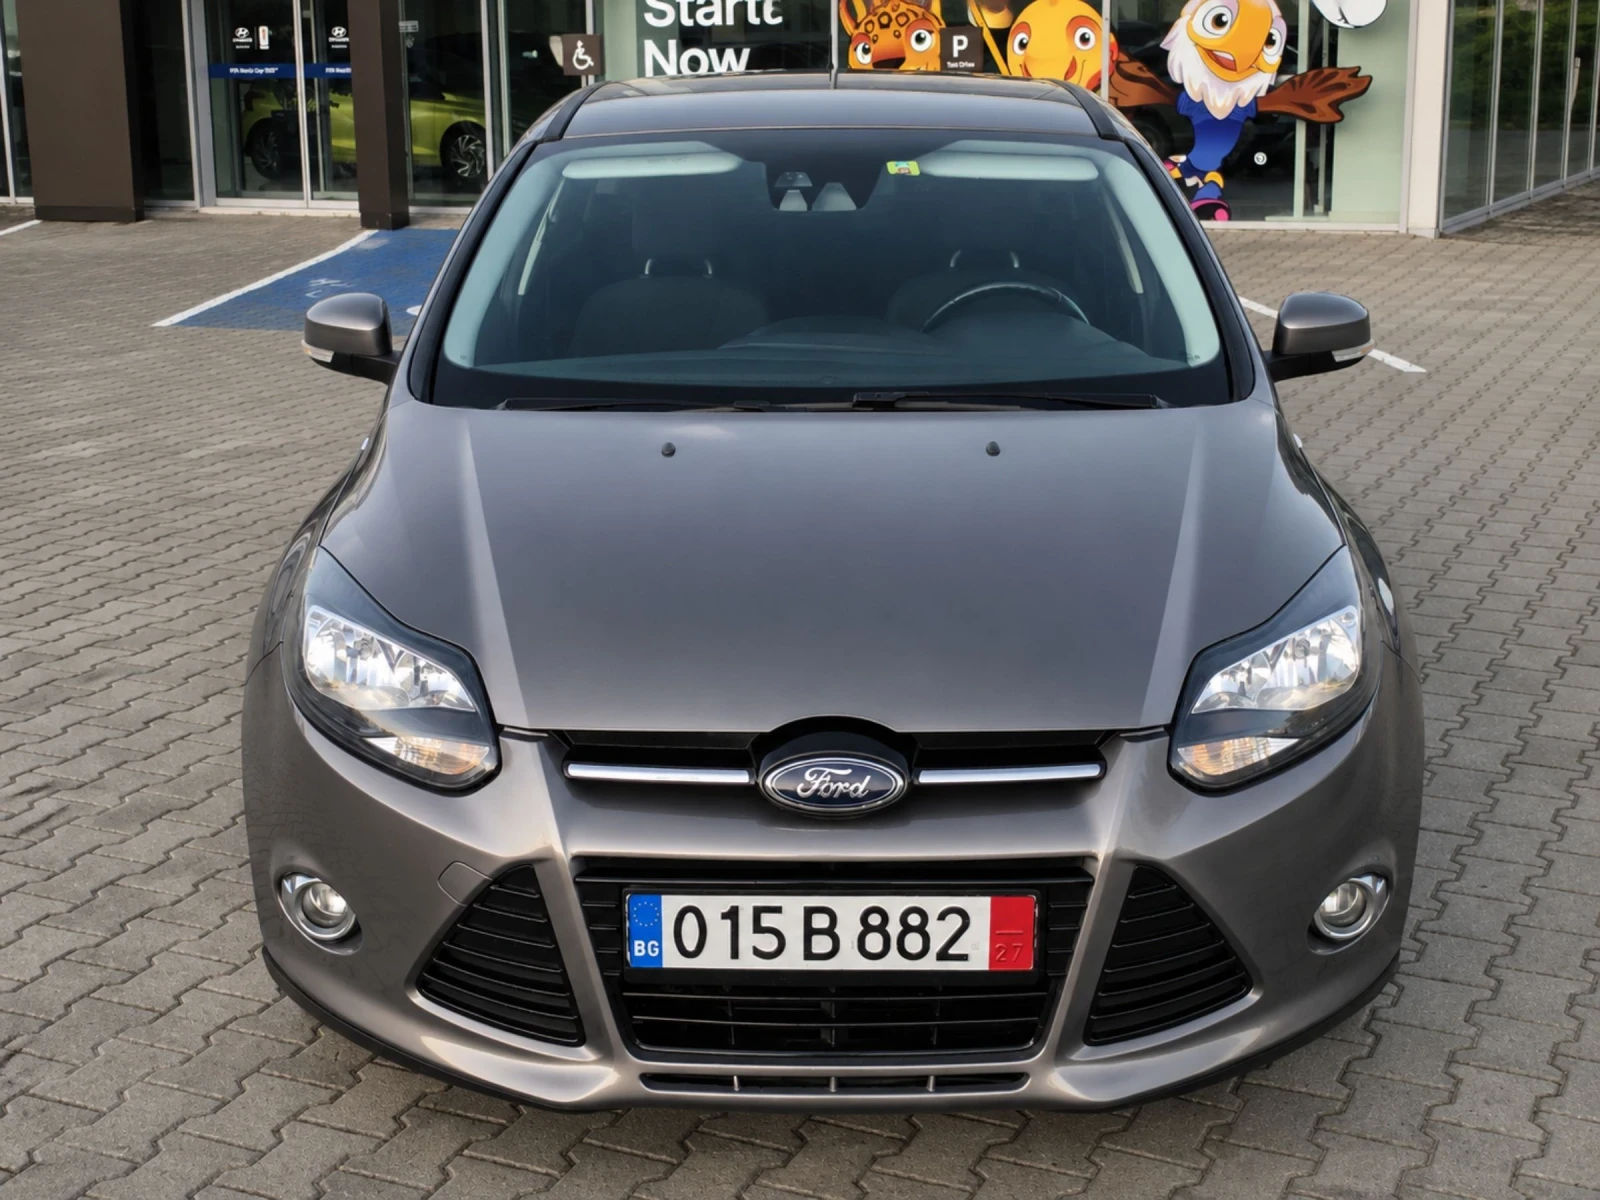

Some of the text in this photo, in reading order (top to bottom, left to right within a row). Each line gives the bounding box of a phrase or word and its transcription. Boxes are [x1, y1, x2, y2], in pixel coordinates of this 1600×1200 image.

[644, 39, 751, 77] Now
[953, 35, 969, 58] P
[797, 767, 871, 798] Ford
[633, 940, 660, 957] BG
[995, 943, 1024, 963] 27
